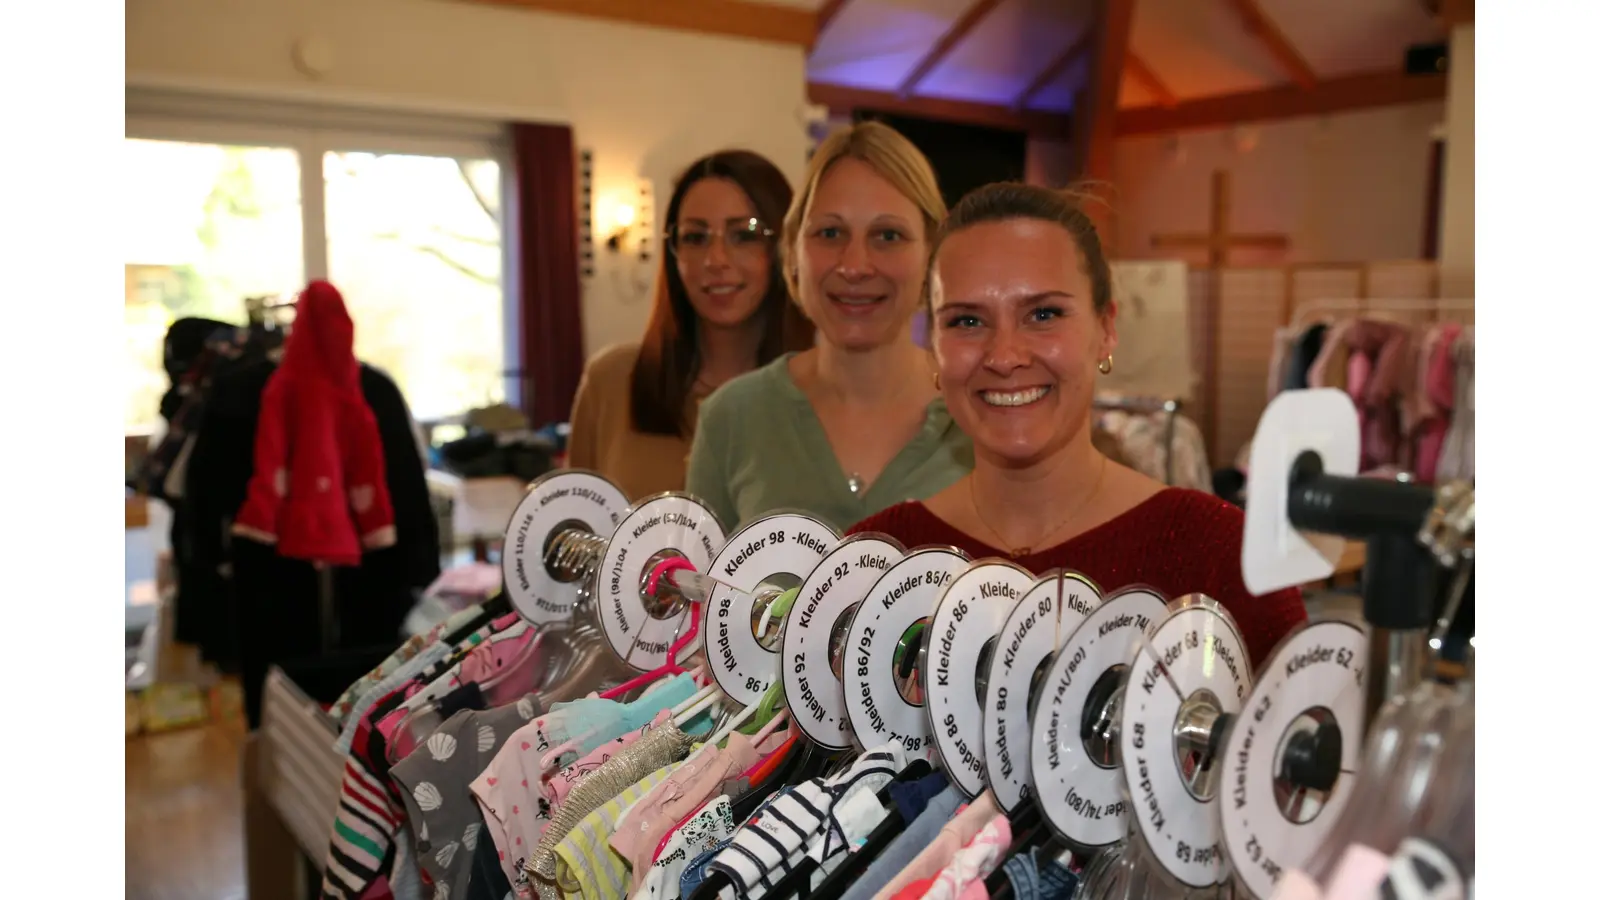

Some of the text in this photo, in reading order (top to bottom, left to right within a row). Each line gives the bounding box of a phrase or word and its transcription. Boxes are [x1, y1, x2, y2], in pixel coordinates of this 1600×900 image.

[516, 558, 530, 591] Kleider
[541, 489, 570, 507] Kleider
[632, 516, 662, 539] Kleider
[769, 530, 785, 544] 98
[611, 548, 628, 595] (98/)104
[724, 538, 766, 577] Kleider
[834, 562, 850, 580] 92
[614, 598, 630, 634] Kleider
[718, 599, 731, 617] 98
[799, 576, 833, 628] Kleider
[952, 599, 968, 622] 86
[1038, 596, 1052, 617] 80
[857, 626, 876, 677] 86/92
[882, 575, 923, 610] Kleider
[1098, 612, 1134, 638] Kleider
[1185, 630, 1199, 650] 68
[717, 622, 738, 672] Kleider
[794, 652, 806, 673] 92
[937, 621, 957, 686] Kleider
[1212, 635, 1240, 682] Kleider
[745, 677, 761, 693] 98
[1052, 646, 1086, 704] 74(/80)
[1142, 641, 1182, 695] Kleder
[798, 677, 827, 722] Kleider
[996, 687, 1008, 711] 80
[944, 713, 958, 738] 86
[1047, 710, 1061, 770] Kleider
[1132, 722, 1145, 749] 68
[1233, 728, 1256, 809] Kleider
[1254, 695, 1272, 722] 62
[1286, 645, 1334, 679] Kleider
[1336, 647, 1354, 670] 62
[995, 718, 1013, 780] Kleider
[1137, 756, 1166, 832] Kleider
